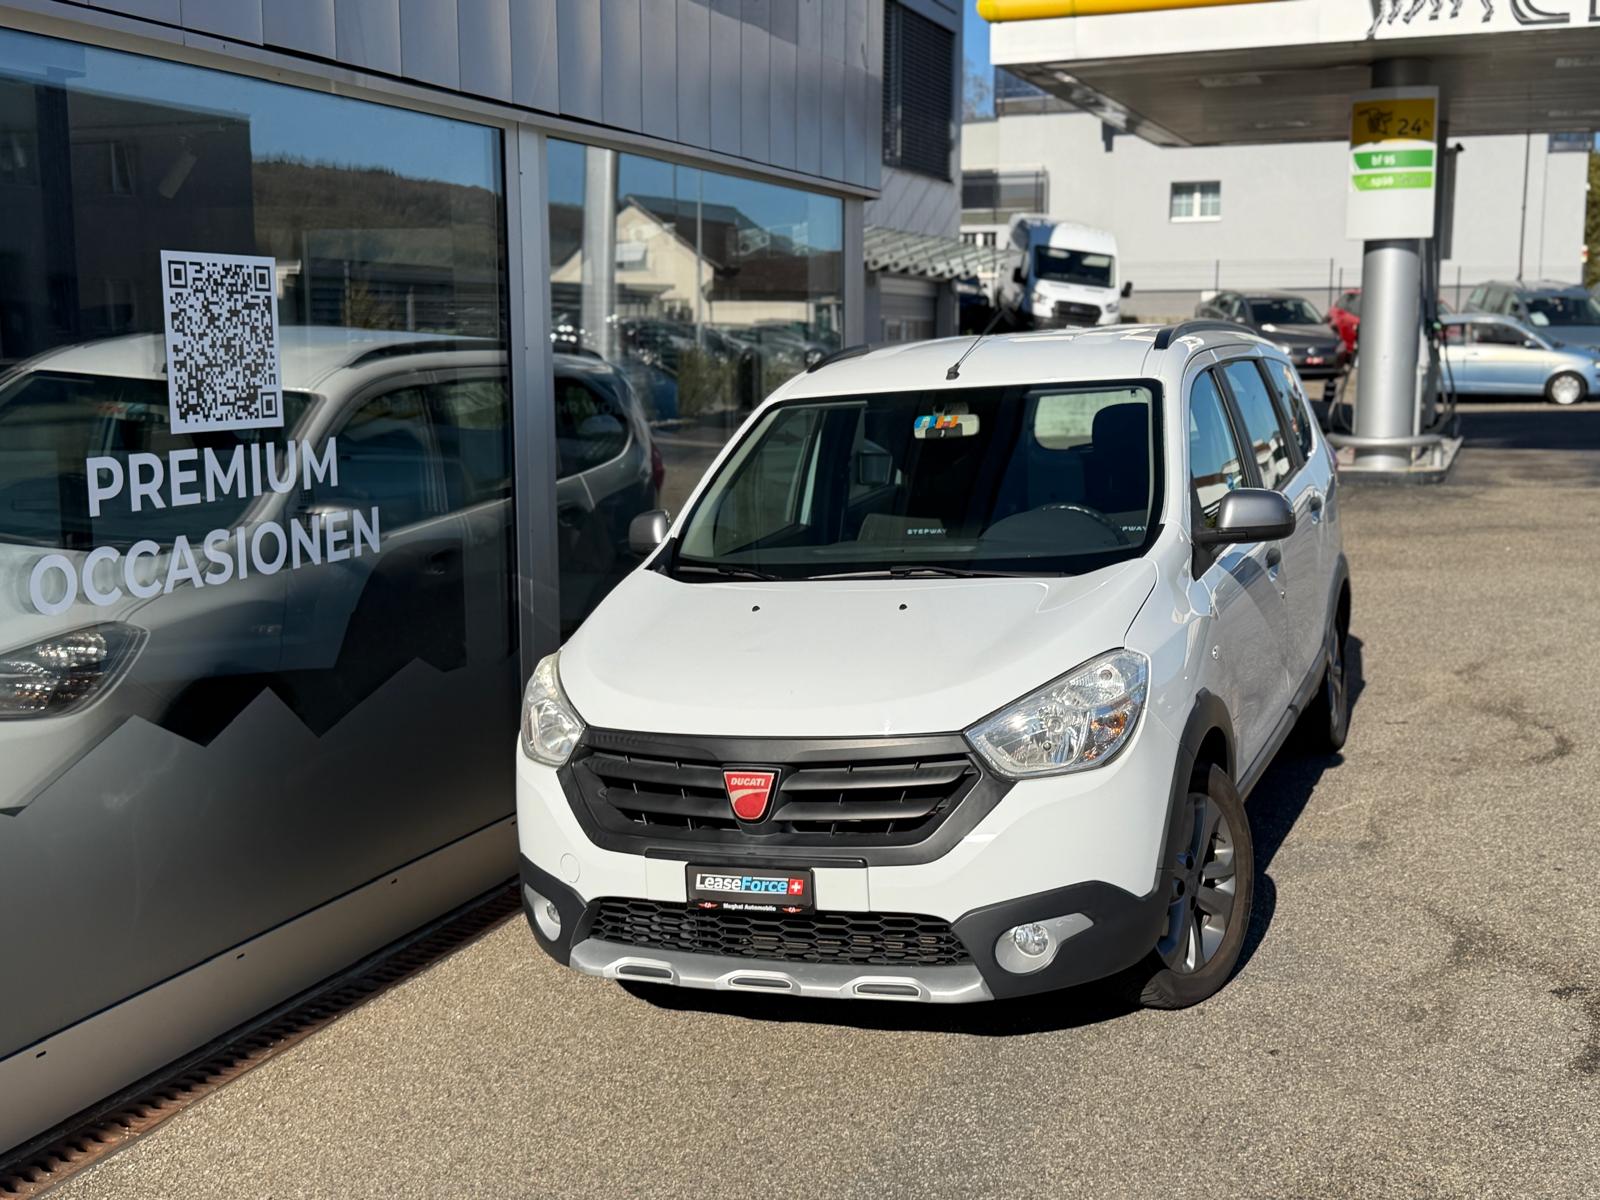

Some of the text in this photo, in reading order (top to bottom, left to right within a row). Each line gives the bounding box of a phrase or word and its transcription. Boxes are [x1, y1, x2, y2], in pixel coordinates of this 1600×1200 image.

[86, 436, 339, 517] PREMIUM
[29, 506, 381, 616] OCCASIONEN
[730, 777, 766, 787] DUCATI
[695, 873, 789, 894] LeaseForce
